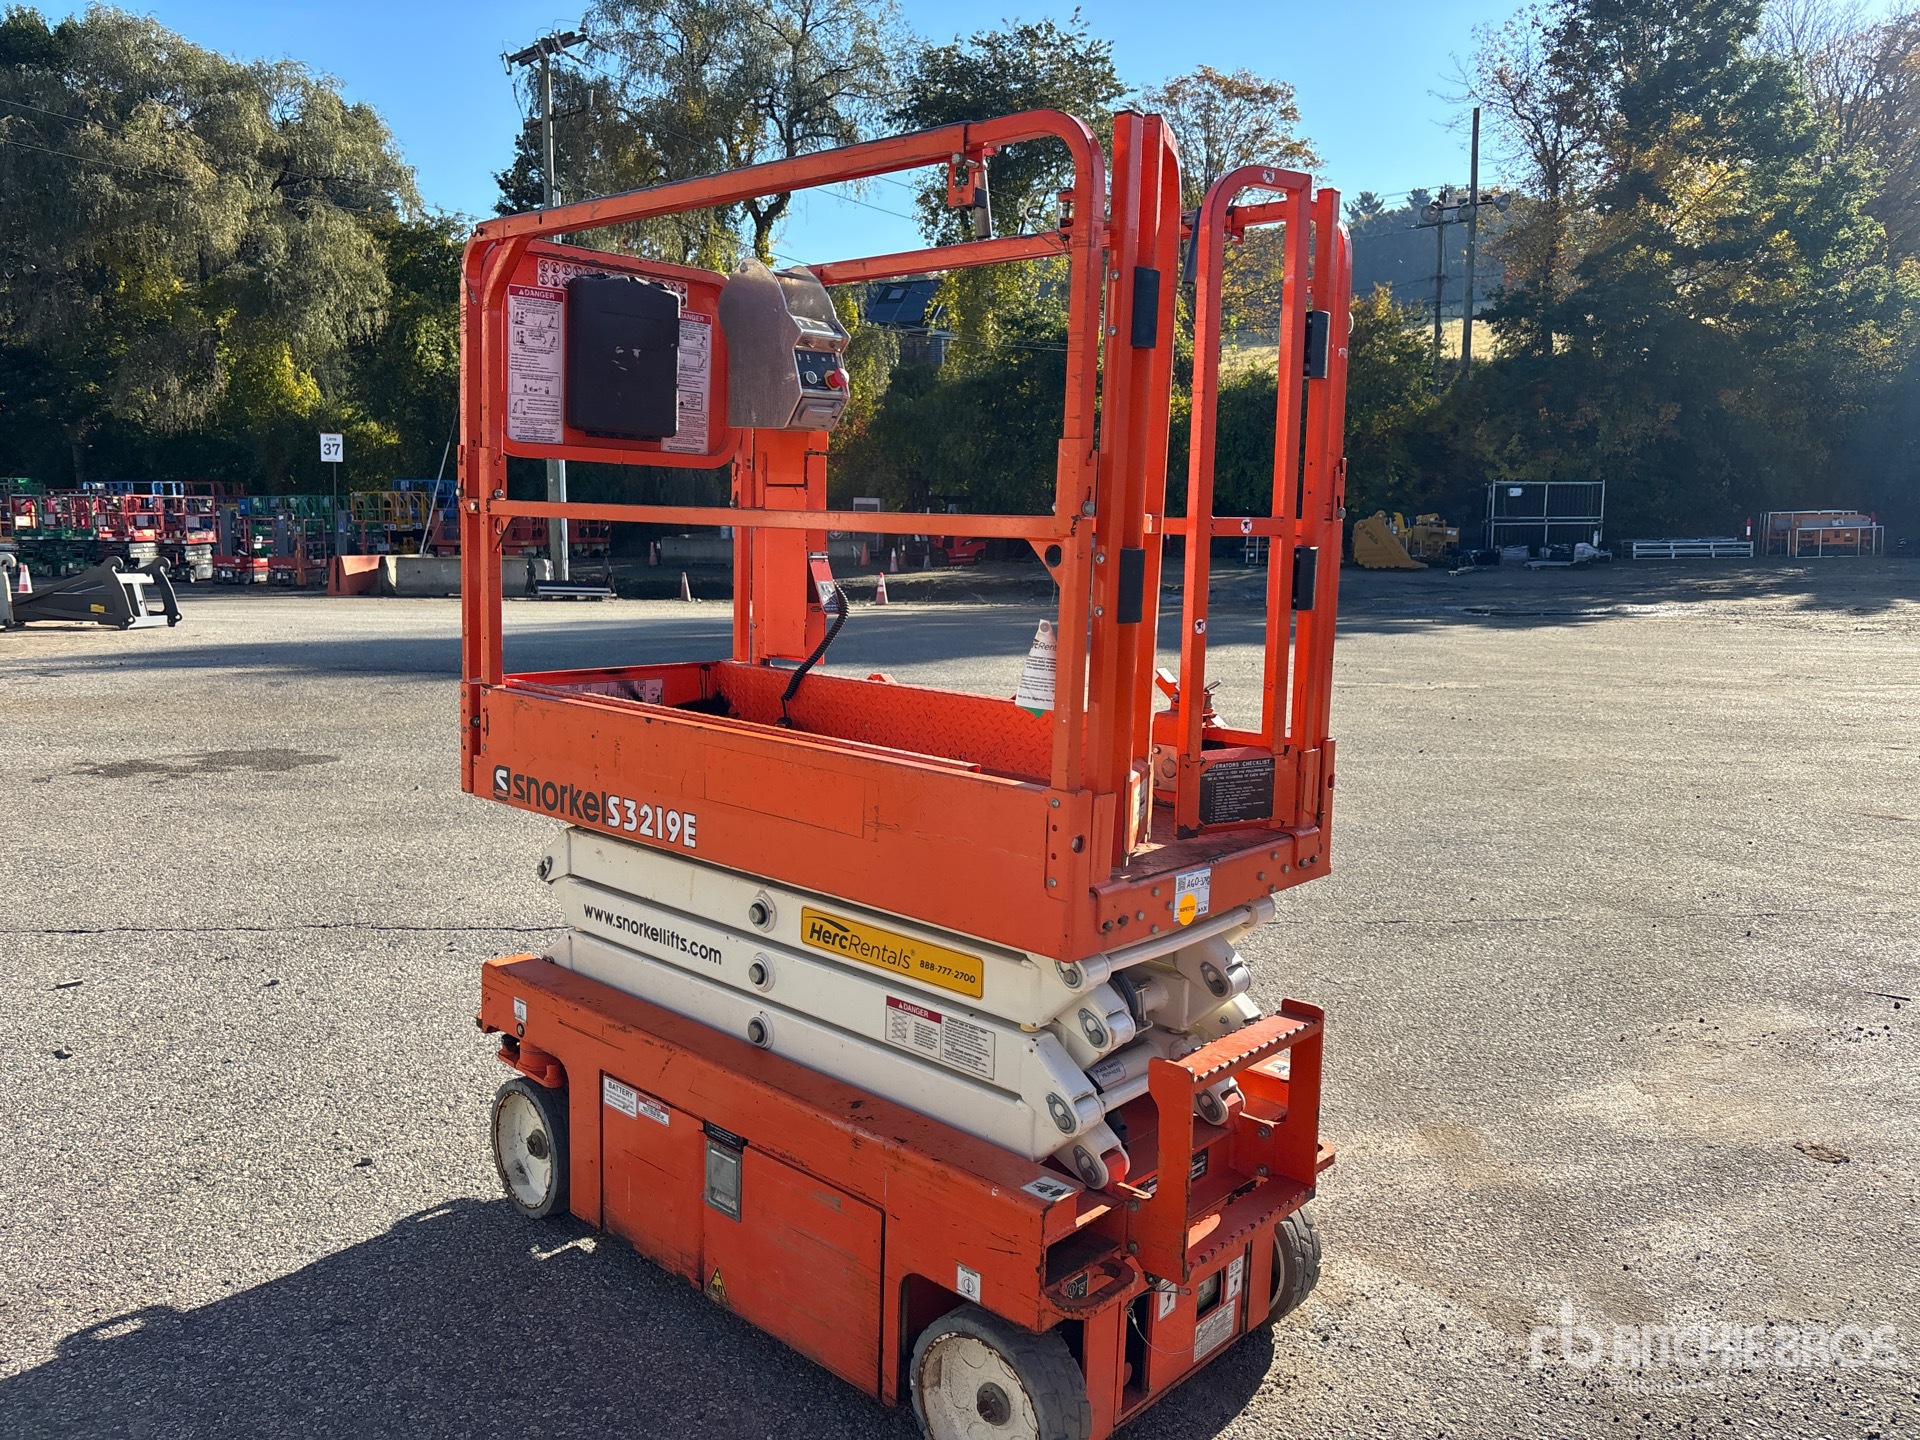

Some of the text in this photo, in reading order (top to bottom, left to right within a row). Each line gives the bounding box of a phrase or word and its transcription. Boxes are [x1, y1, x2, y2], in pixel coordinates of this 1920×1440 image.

[524, 289, 555, 300] DANGER
[323, 443, 341, 456] 37
[1242, 759, 1271, 767] CHECKLIST
[512, 772, 607, 826] snorkel
[607, 795, 697, 849] S3219E
[583, 903, 722, 965] www.snorkellifts.com
[919, 959, 976, 984] 888-777-2700
[903, 1003, 929, 1018] DANGER
[608, 1081, 633, 1099] BATTERY
